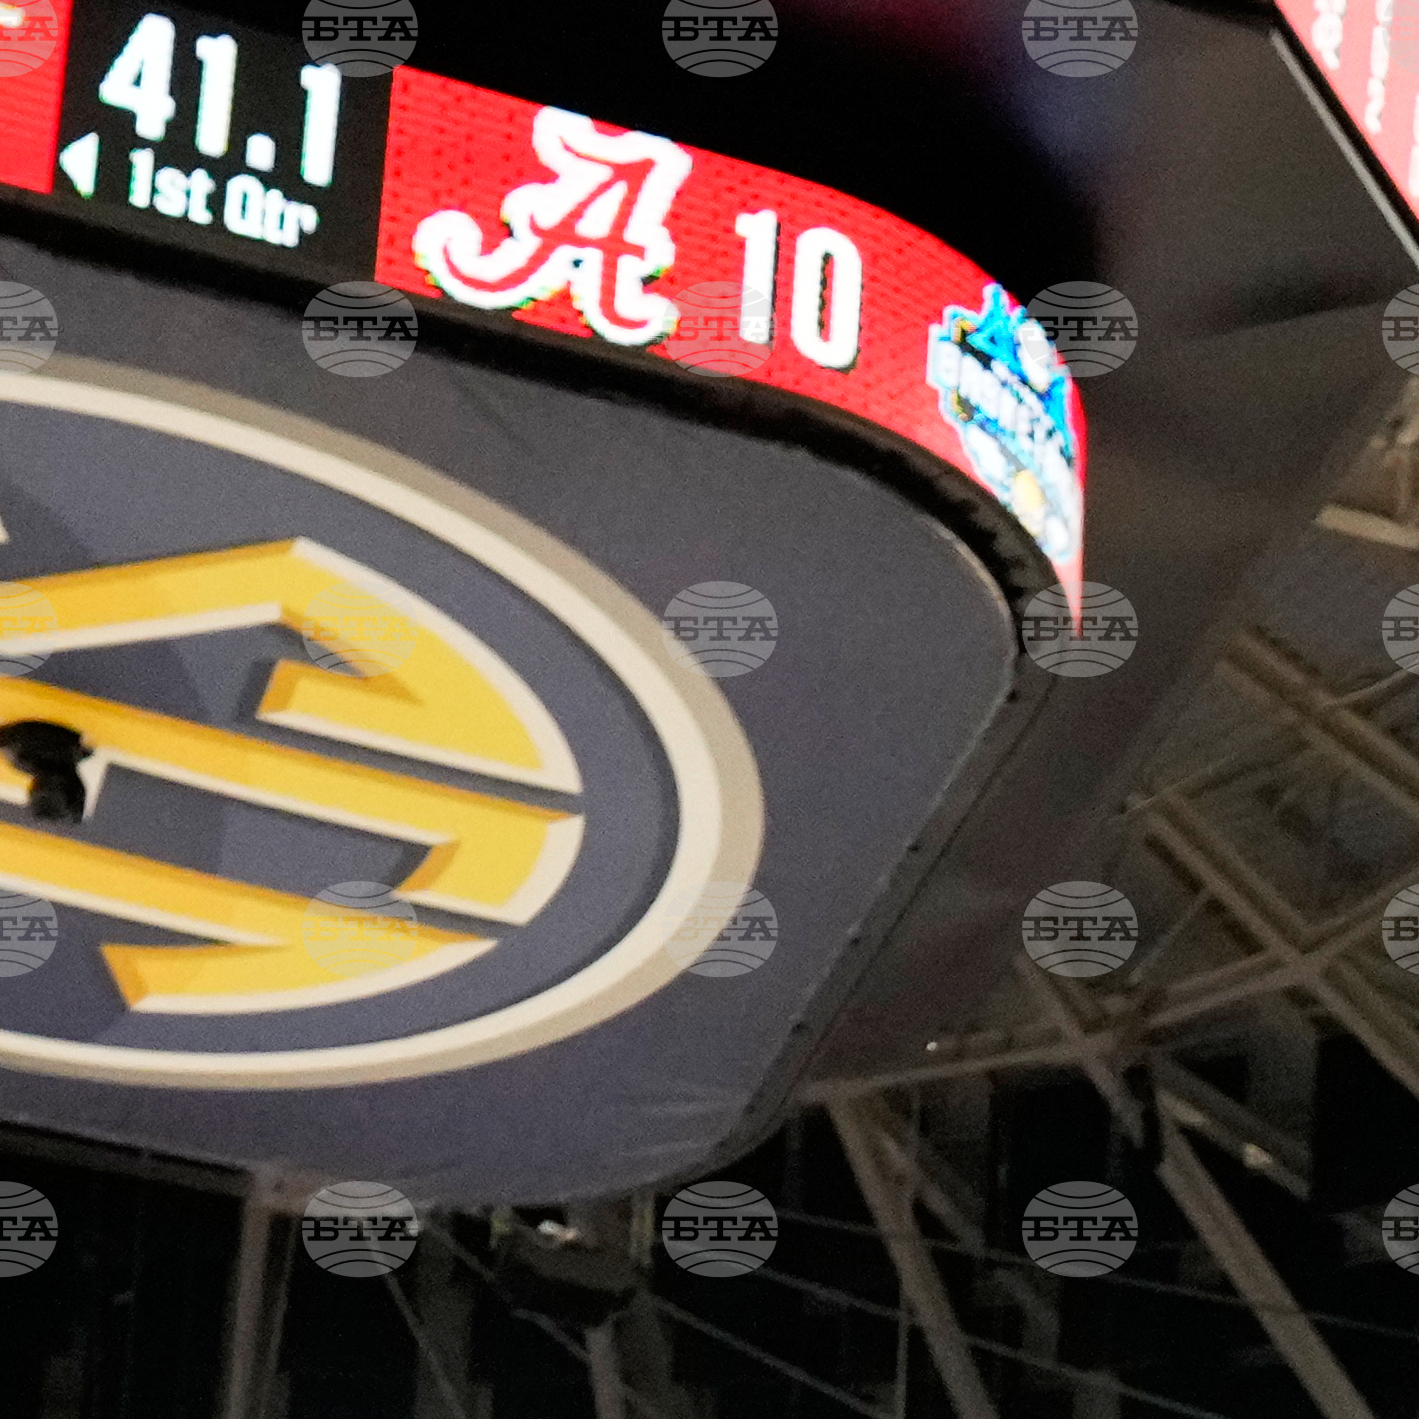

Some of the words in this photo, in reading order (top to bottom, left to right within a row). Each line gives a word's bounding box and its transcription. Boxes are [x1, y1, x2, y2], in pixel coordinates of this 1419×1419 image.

[98, 12, 342, 187] 41.1
[128, 148, 217, 225] 1st
[223, 173, 321, 248] Qtr
[734, 208, 863, 371] 10
